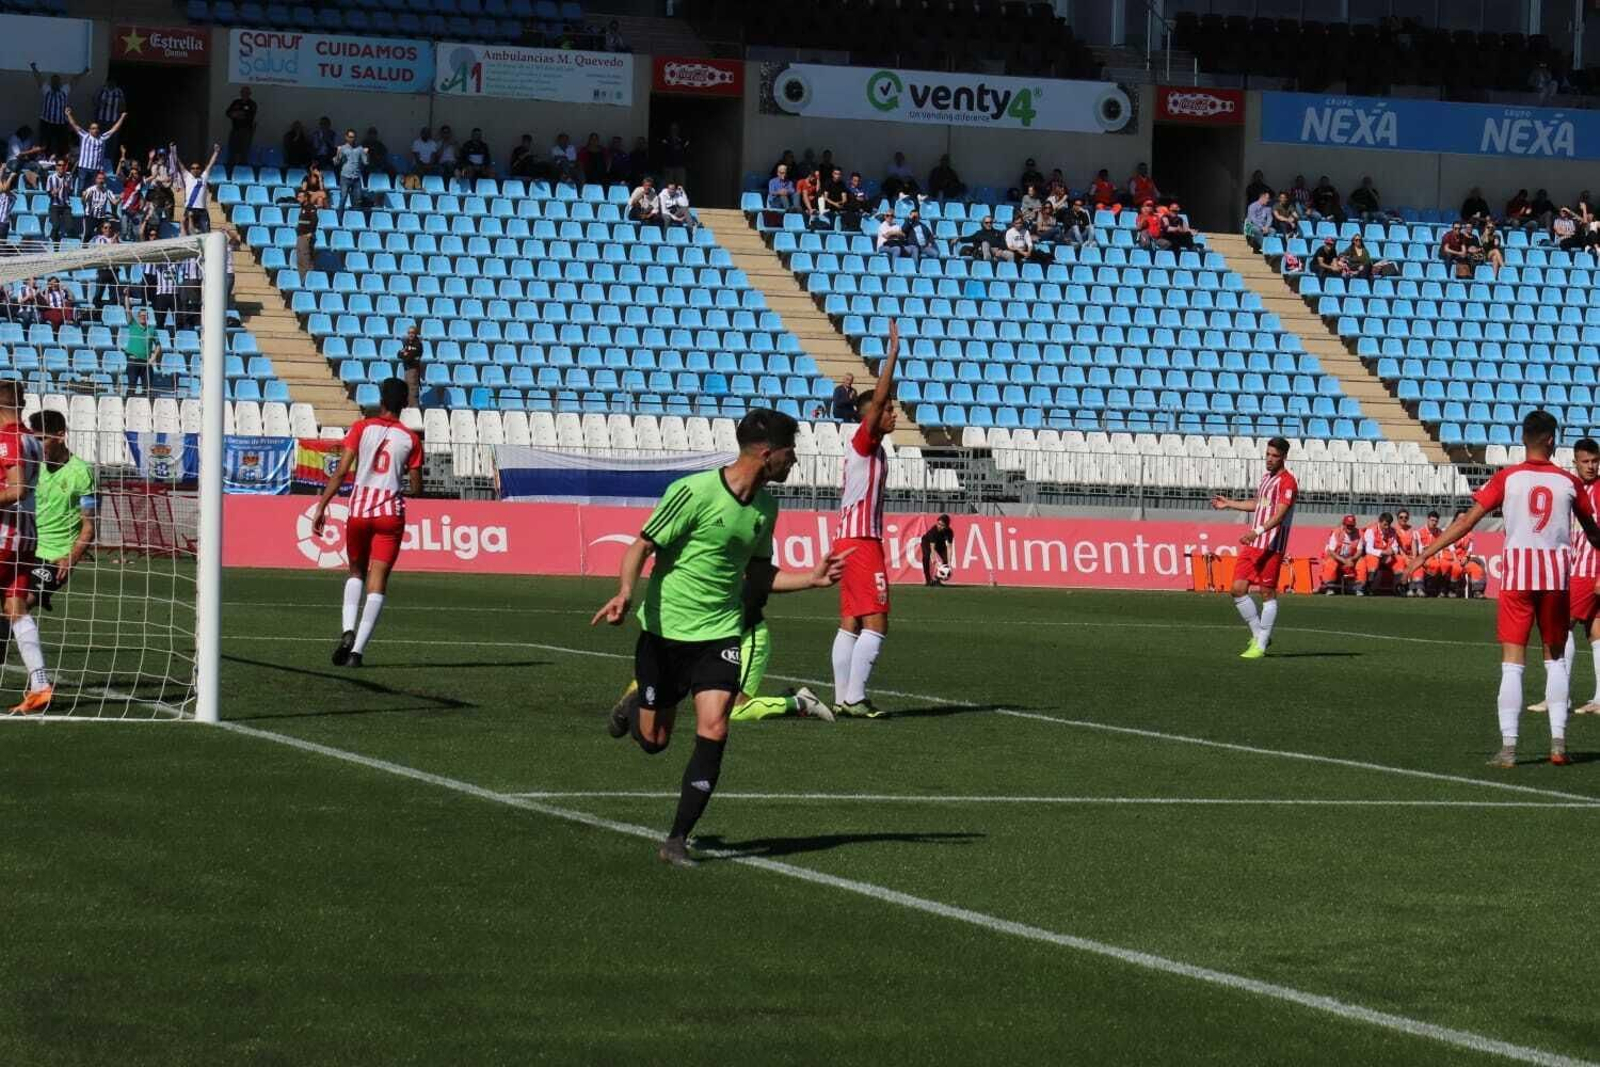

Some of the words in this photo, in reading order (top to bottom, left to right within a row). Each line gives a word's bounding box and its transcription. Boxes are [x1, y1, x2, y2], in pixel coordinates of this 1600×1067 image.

[149, 32, 205, 51] Estrella
[239, 31, 303, 57] Sanur
[315, 41, 418, 61] CUIDAMOS
[239, 51, 299, 76] Salud
[482, 50, 554, 64] Ambulancias
[574, 55, 624, 68] Quevedo
[318, 63, 343, 78] TU
[351, 64, 414, 82] SALUD
[372, 438, 391, 474] 6
[1529, 485, 1553, 534] 9
[400, 514, 508, 560] aLiga
[873, 572, 886, 591] 5
